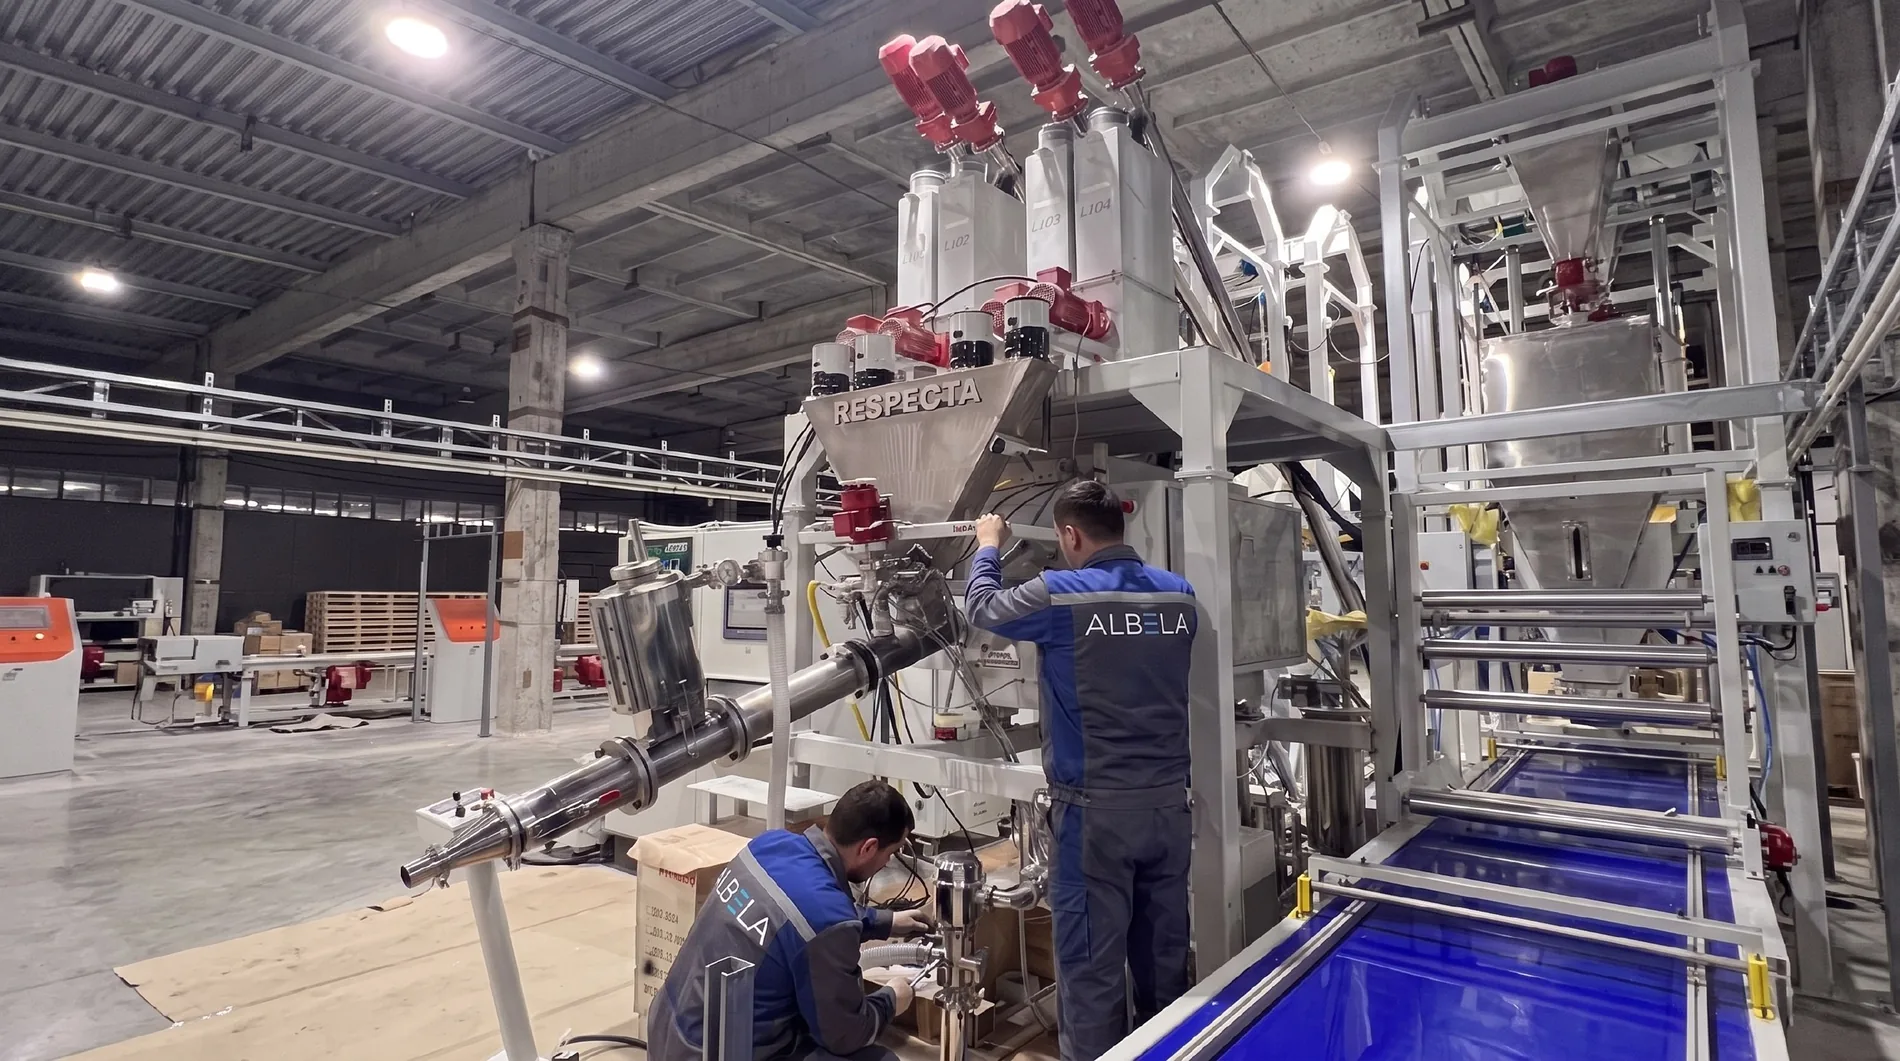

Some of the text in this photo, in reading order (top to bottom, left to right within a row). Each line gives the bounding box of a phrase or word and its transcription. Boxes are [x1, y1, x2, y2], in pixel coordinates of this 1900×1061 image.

[1080, 198, 1112, 218] L104
[1031, 213, 1061, 233] L103
[944, 234, 970, 252] L102
[833, 377, 982, 425] RESPECTA
[1085, 612, 1190, 636] ALBELA
